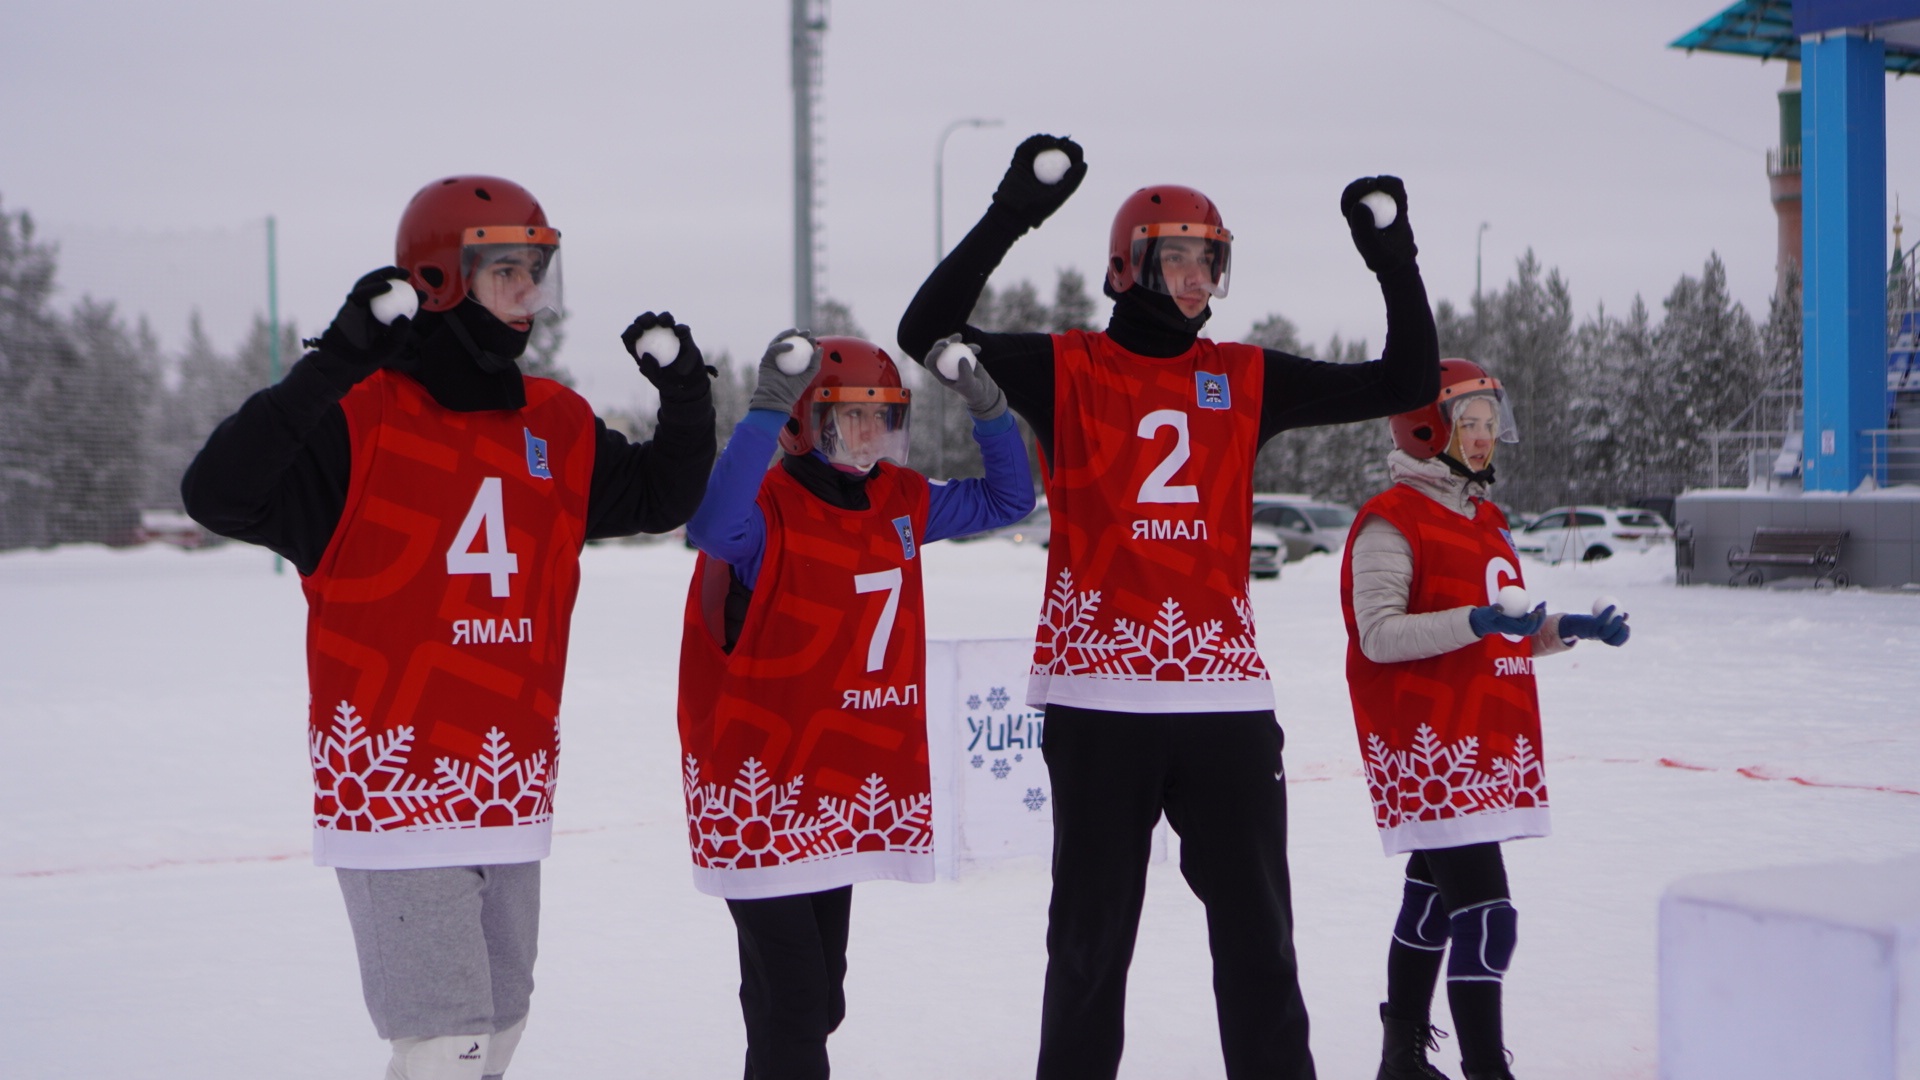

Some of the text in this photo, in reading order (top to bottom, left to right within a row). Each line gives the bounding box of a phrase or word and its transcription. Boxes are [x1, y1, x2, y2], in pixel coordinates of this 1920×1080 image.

[1137, 409, 1199, 503] 2
[446, 477, 518, 597] 4
[1132, 519, 1207, 540] ЯМАЛ
[452, 618, 532, 644] ЯМАЛ
[854, 567, 903, 673] 7
[1494, 656, 1535, 676] ЯМАЛ
[841, 684, 918, 709] ЯМАЛ
